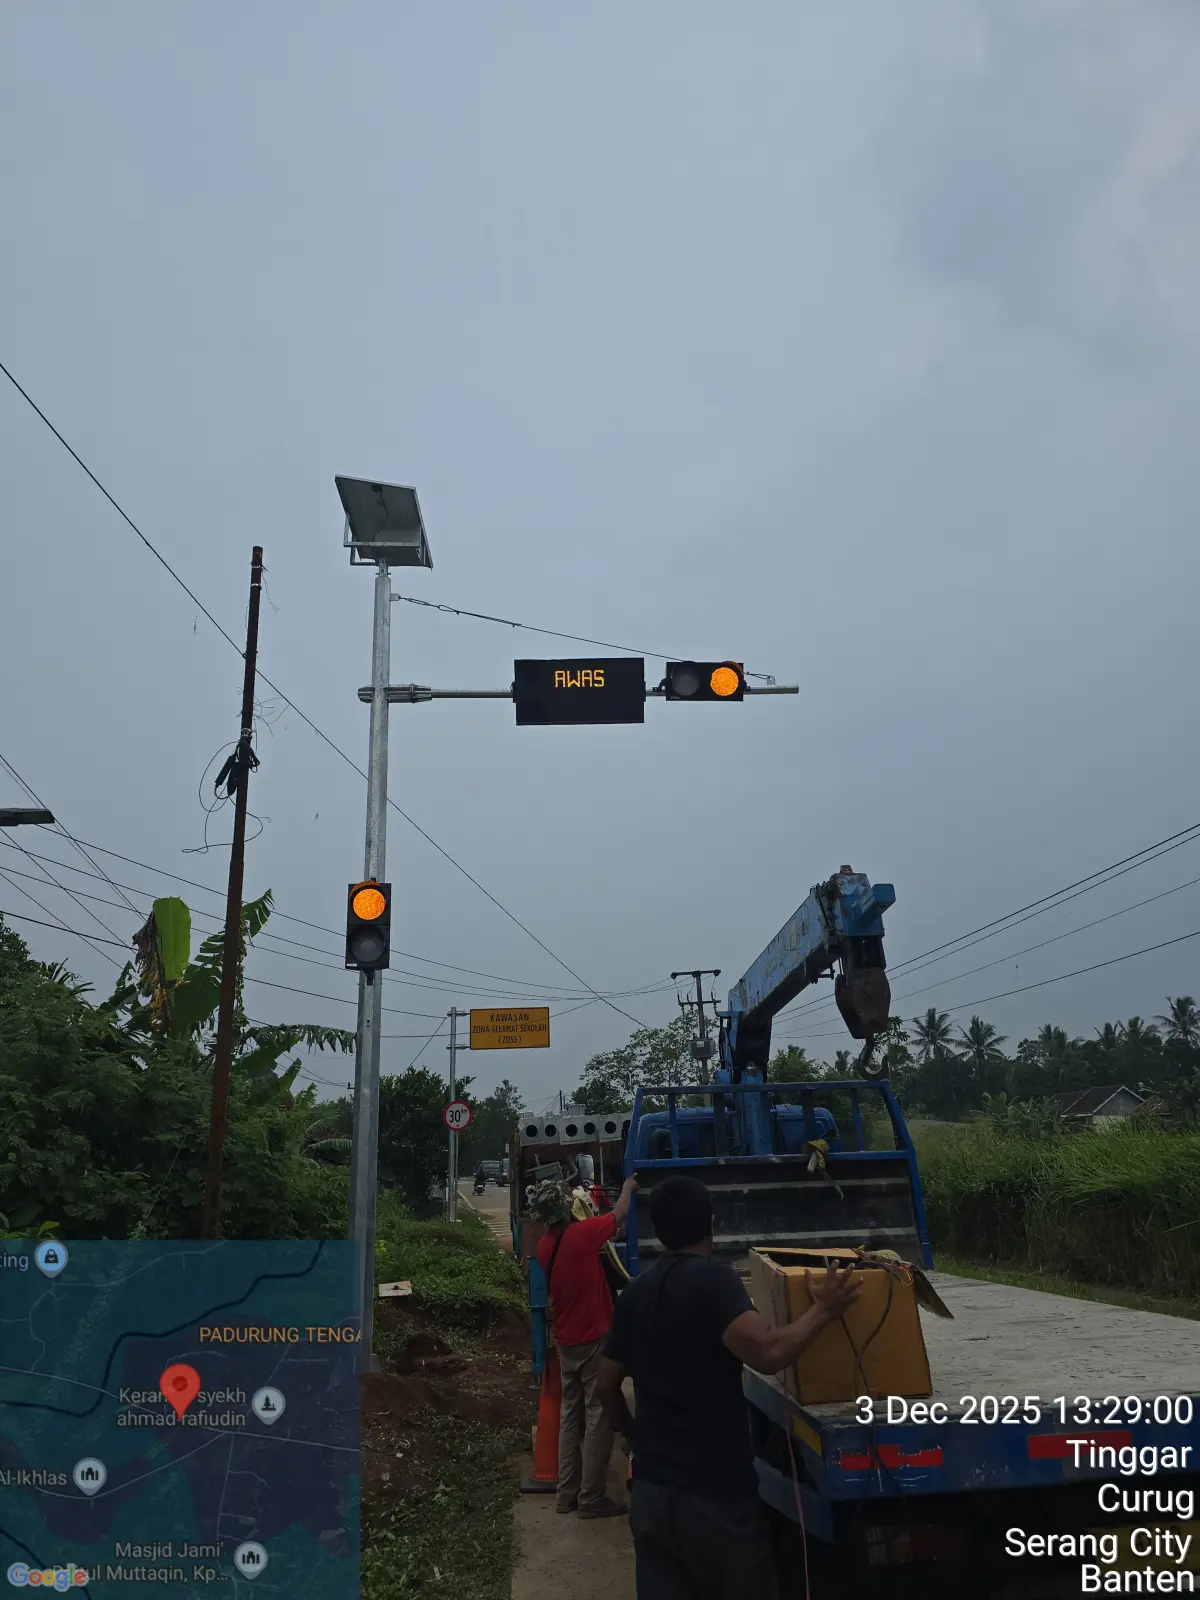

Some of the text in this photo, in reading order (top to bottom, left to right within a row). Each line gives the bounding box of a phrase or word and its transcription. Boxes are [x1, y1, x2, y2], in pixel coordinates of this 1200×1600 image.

[554, 669, 604, 688] AWAS
[490, 1013, 529, 1022] KAWASAN
[472, 1023, 547, 1034] ZONA SELAMAT SEKOLAH
[448, 1109, 460, 1122] 30
